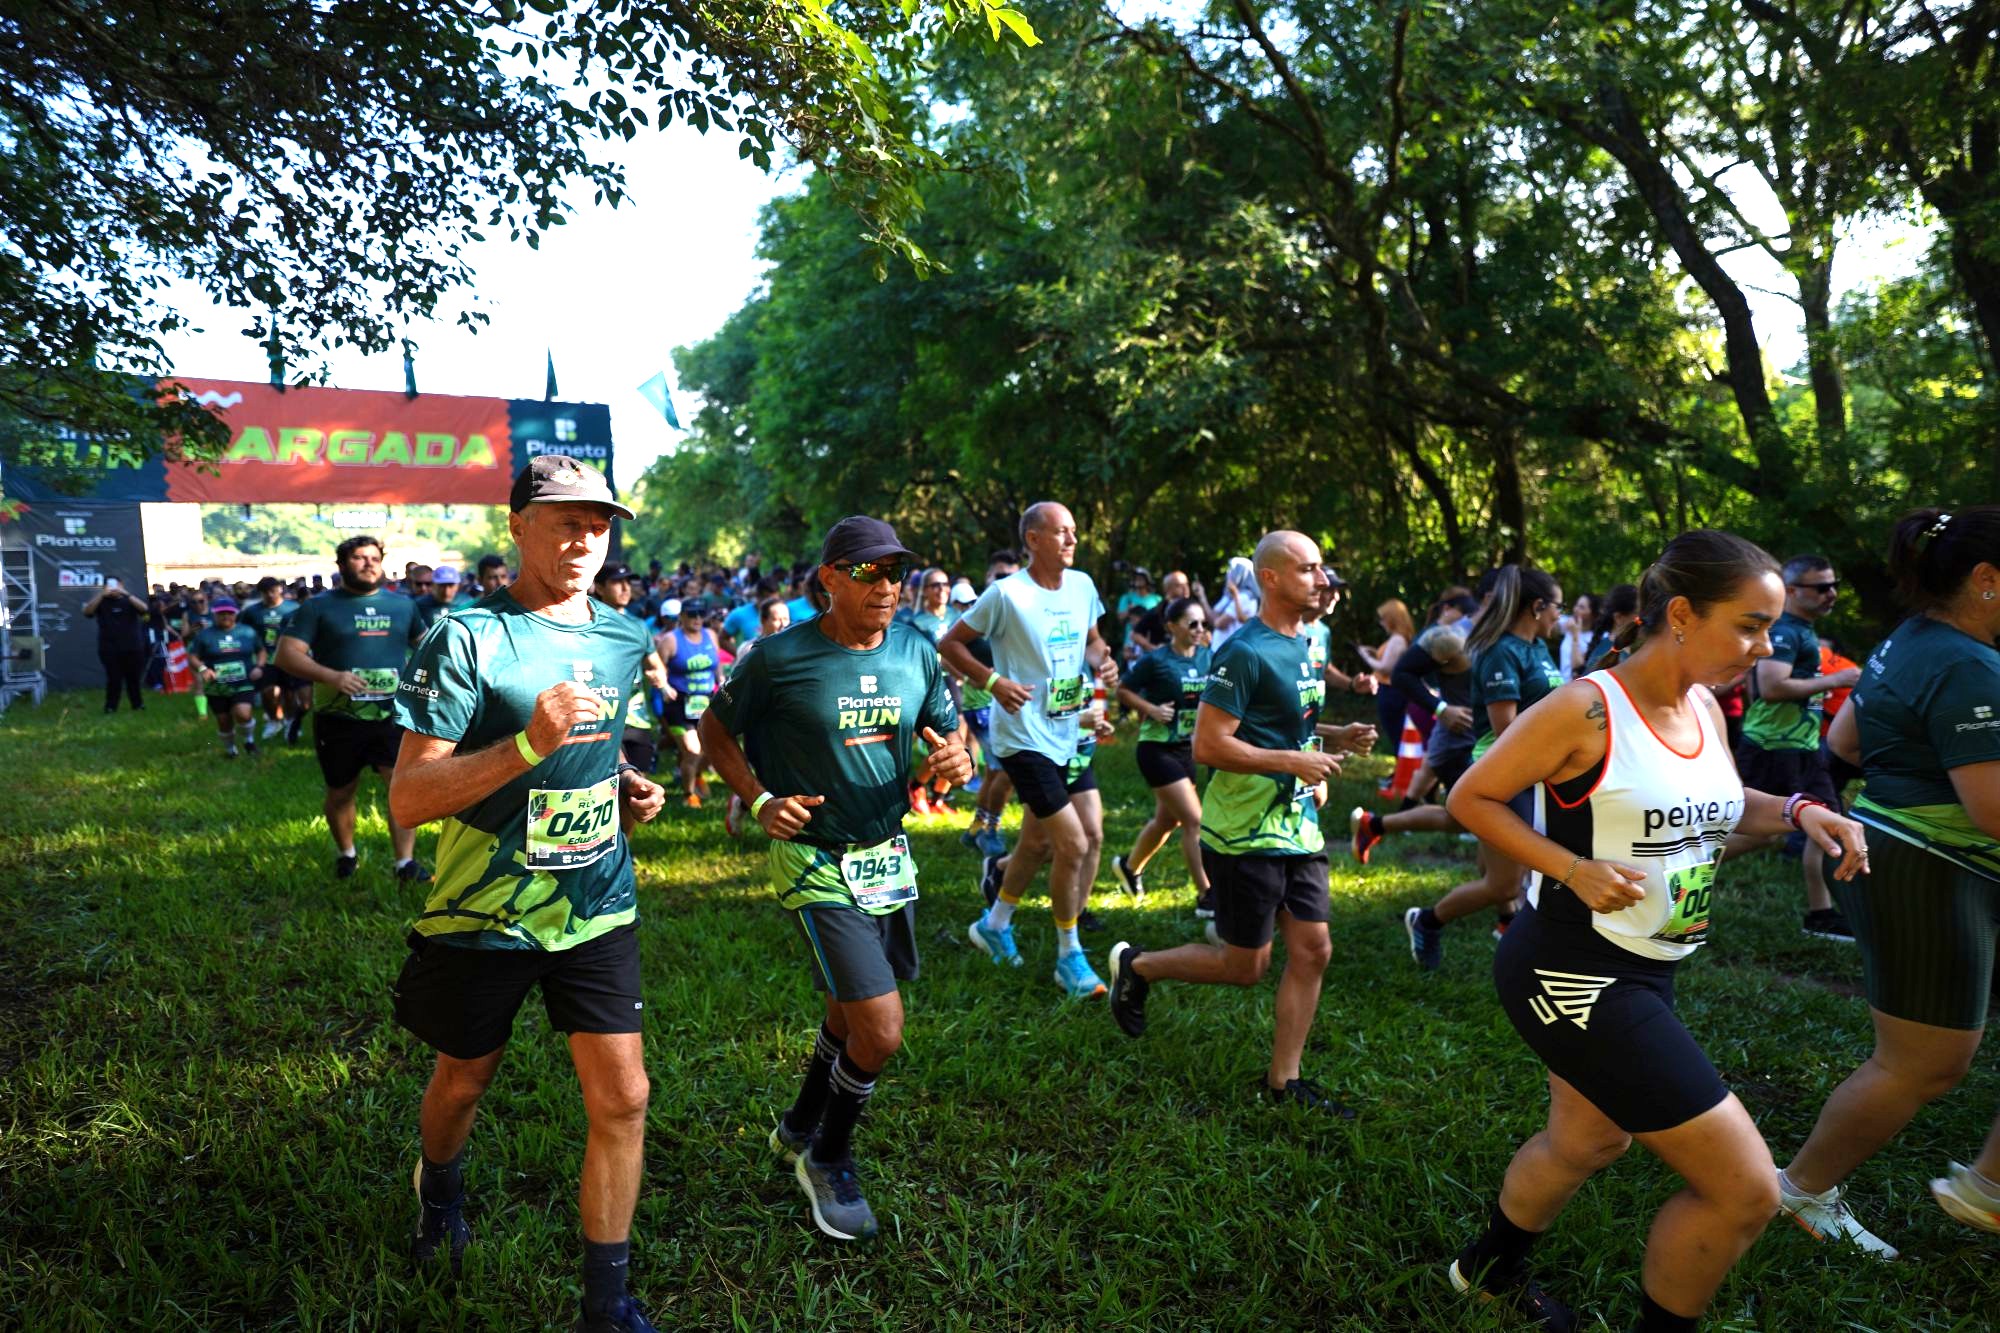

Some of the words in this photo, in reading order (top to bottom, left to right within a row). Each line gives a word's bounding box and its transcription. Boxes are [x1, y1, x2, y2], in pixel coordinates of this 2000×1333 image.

[182, 424, 498, 468] ARGADA
[526, 439, 608, 458] Planeta
[35, 533, 117, 548] Planeta
[355, 619, 392, 630] RUN
[838, 695, 902, 710] Planeta
[838, 707, 902, 730] RUN
[546, 799, 614, 838] 0470
[1643, 797, 1720, 838] peixe
[847, 855, 901, 882] 0943
